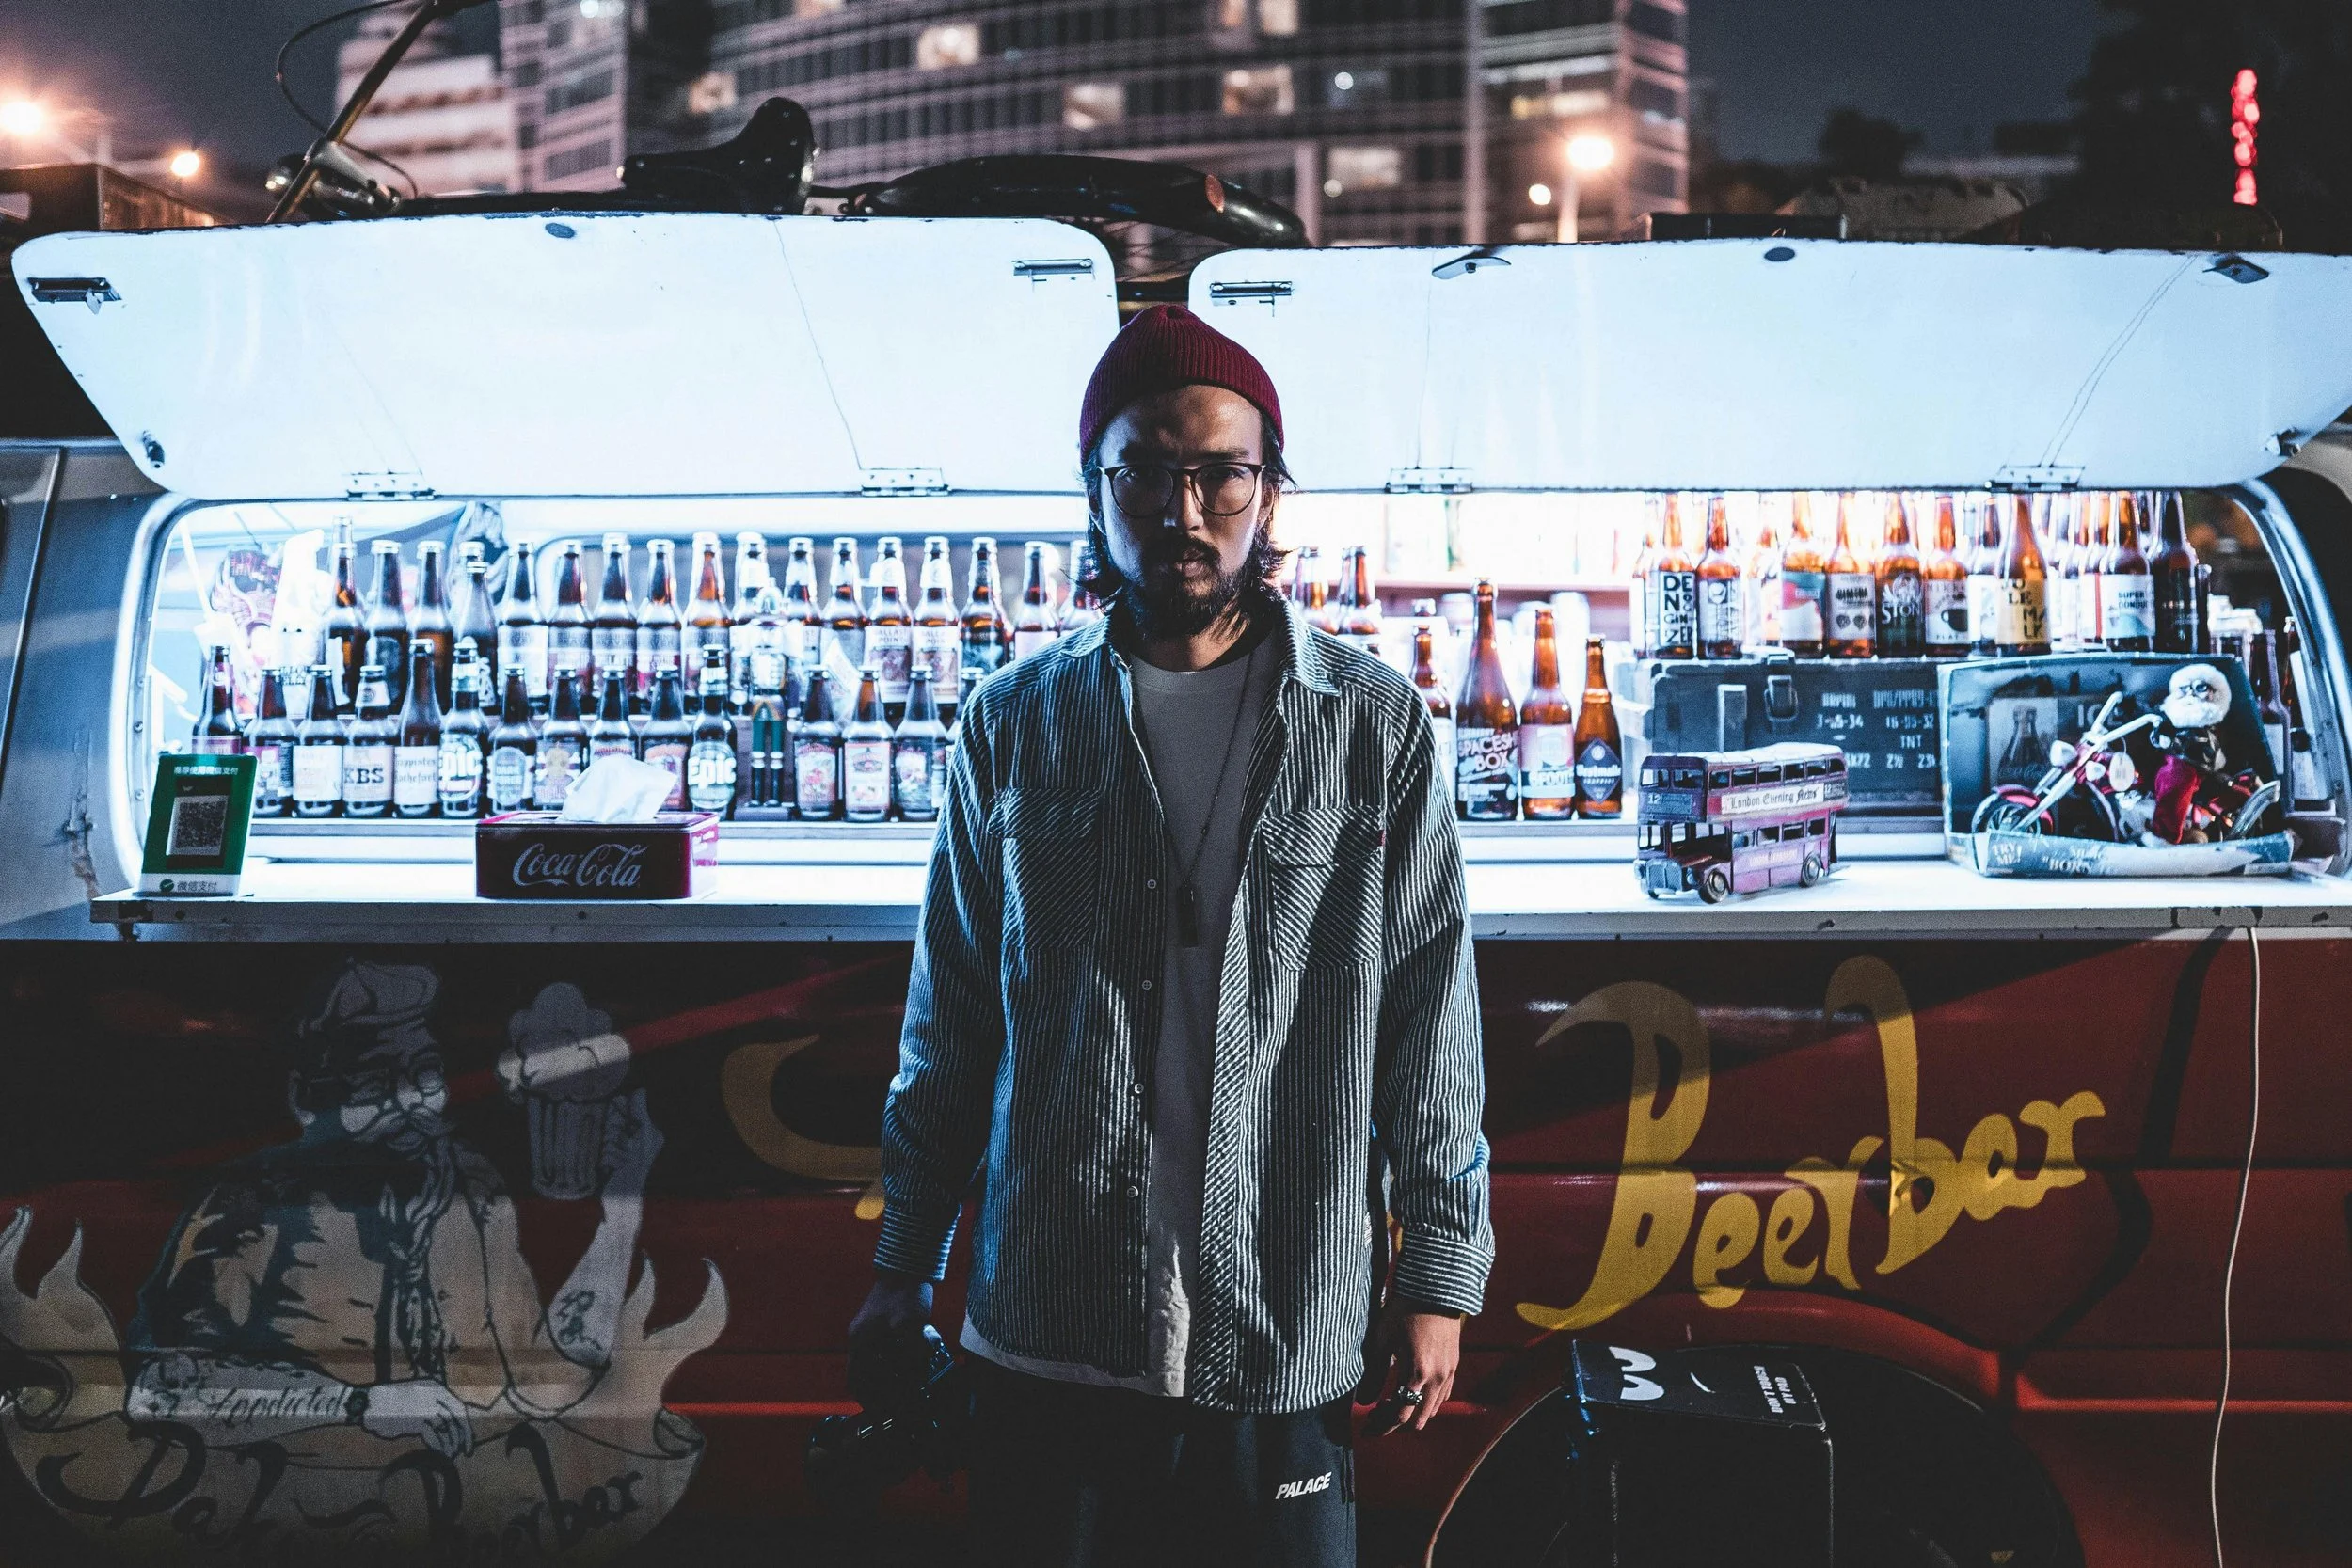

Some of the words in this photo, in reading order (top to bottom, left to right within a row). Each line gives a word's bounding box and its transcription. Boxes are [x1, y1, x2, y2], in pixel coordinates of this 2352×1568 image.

[1474, 750, 1508, 772] BOX
[343, 768, 385, 784] KBS
[1730, 793, 1760, 810] London
[1762, 790, 1794, 807] Evening
[177, 880, 217, 892] 微信支付
[1275, 1471, 1331, 1500] PALACE
